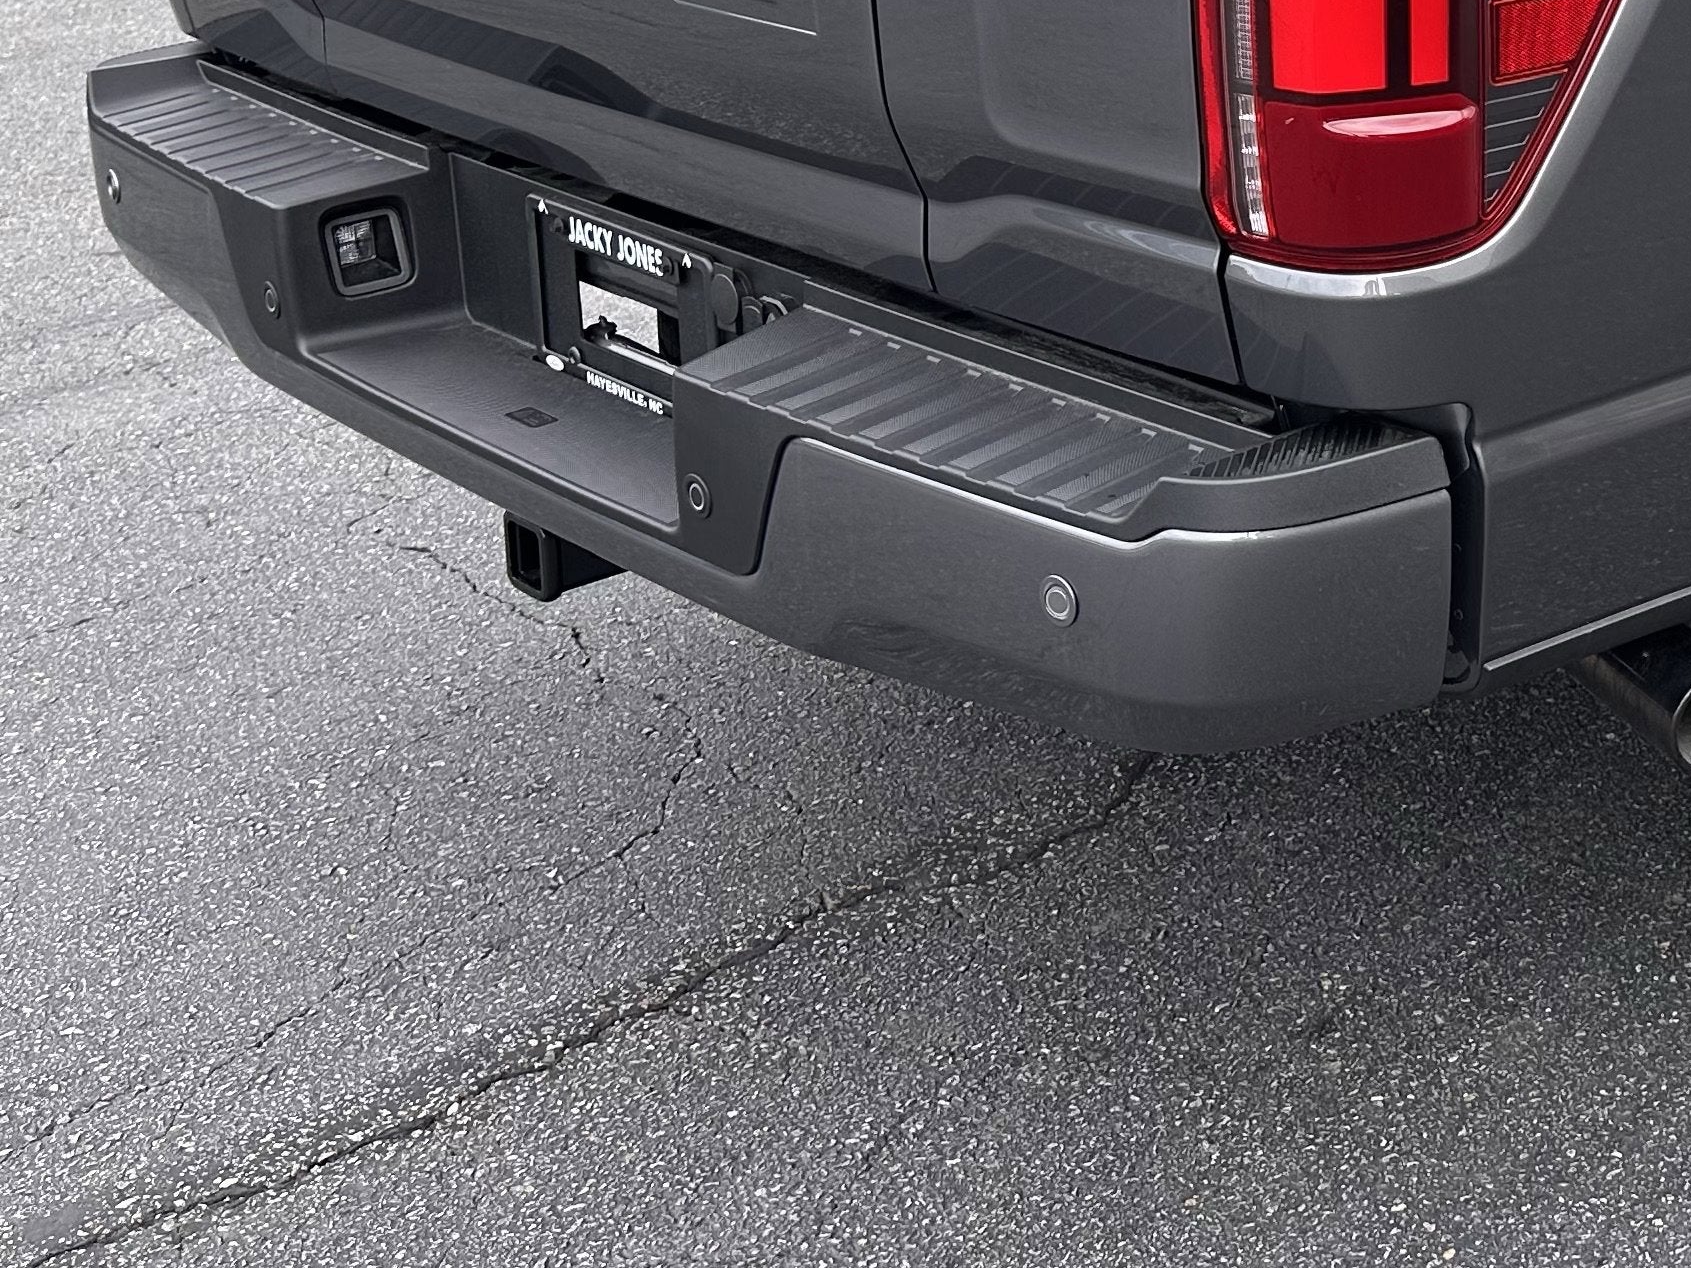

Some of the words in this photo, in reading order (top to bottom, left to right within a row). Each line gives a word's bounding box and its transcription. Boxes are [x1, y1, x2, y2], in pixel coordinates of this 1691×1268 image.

[567, 216, 613, 257] JACKY
[616, 234, 664, 278] JONES
[648, 398, 664, 415] NC
